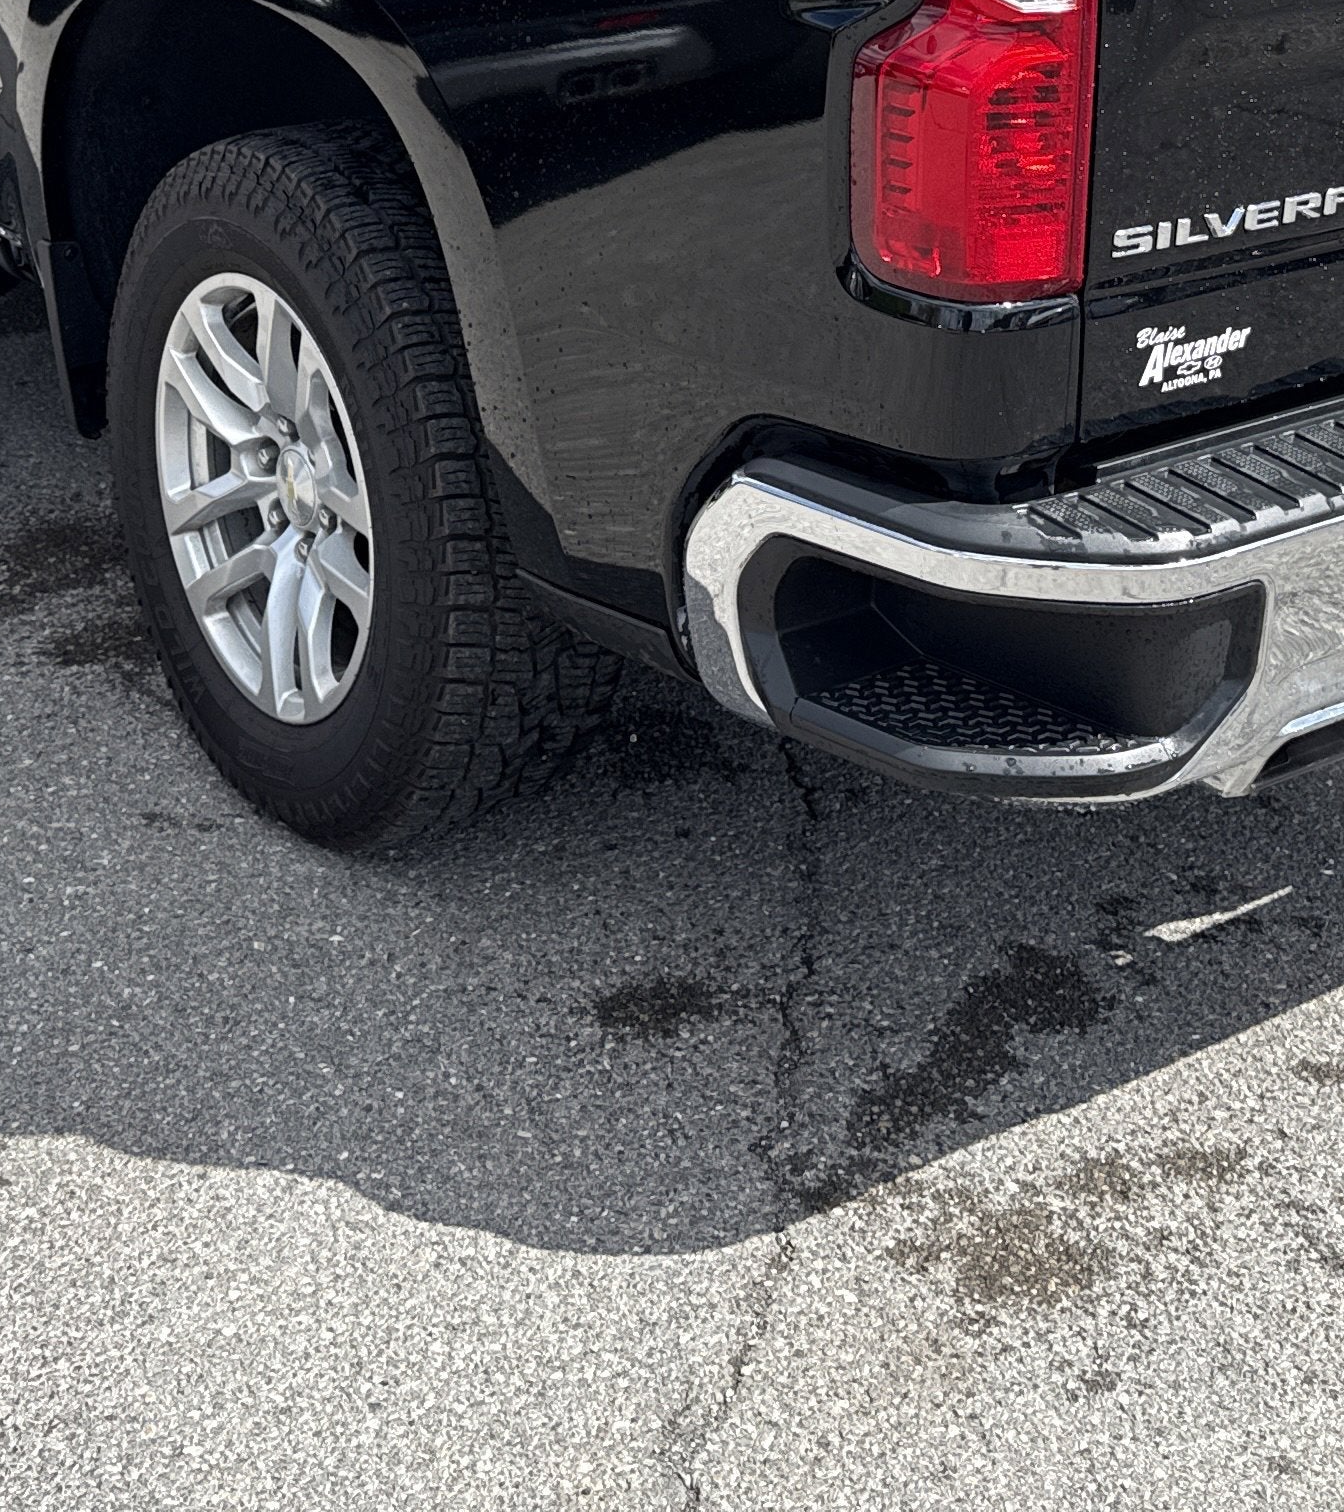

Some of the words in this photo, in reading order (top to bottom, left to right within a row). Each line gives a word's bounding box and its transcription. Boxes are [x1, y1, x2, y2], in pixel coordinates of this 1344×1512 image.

[1136, 326, 1186, 349] Blaise
[1138, 326, 1252, 387] Alexander
[1208, 368, 1222, 380] PA
